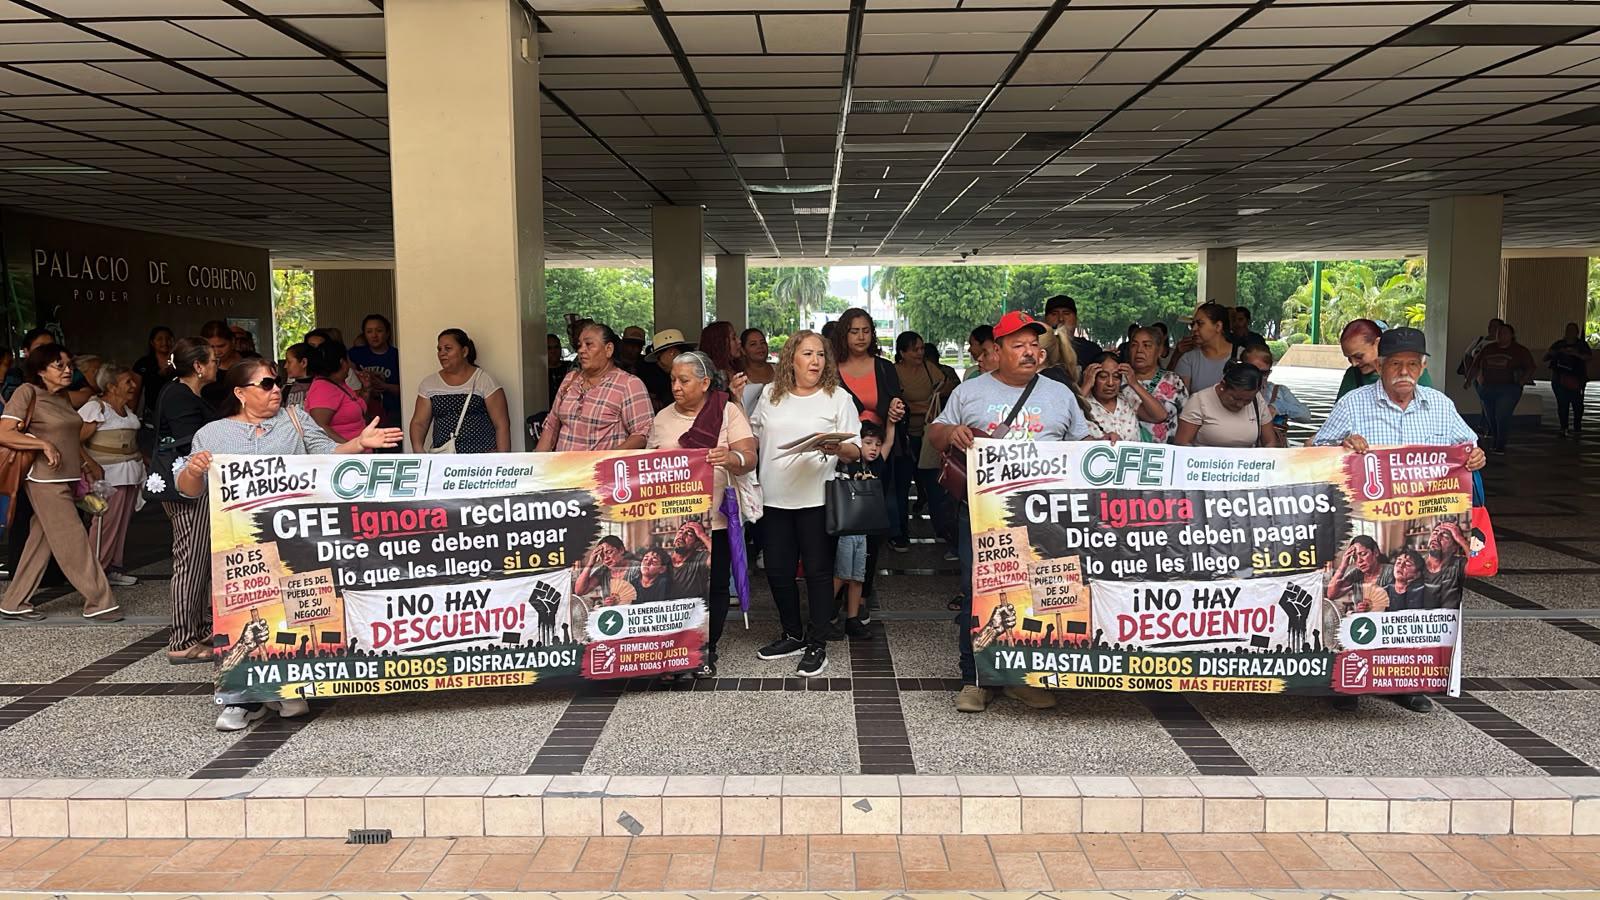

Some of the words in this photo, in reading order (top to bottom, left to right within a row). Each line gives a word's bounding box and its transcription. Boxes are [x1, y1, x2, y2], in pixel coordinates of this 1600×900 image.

[35, 249, 129, 282] PALACIO
[149, 260, 170, 285] DE
[189, 266, 256, 291] GOBIERNO
[74, 289, 128, 302] PODER
[156, 293, 235, 306] EJECUTIVO
[978, 442, 1038, 467] ¡BASTA
[1389, 454, 1403, 466] EL
[1406, 452, 1447, 465] CALOR
[221, 457, 286, 483] ¡BASTA
[638, 460, 651, 471] EL
[654, 456, 689, 470] CALOR
[976, 469, 994, 485] DE
[1001, 455, 1067, 481] ABUSOS!
[1081, 445, 1165, 486] CFE
[1187, 458, 1233, 469] Comisión
[1237, 459, 1275, 470] Federal
[331, 459, 421, 499] CFE
[444, 466, 492, 477] Comisión
[496, 466, 533, 476] Federal
[639, 469, 690, 484] EXTREMO
[1187, 471, 1198, 481] de
[1202, 472, 1260, 482] Electricidad
[1391, 465, 1449, 480] EXTREMO
[221, 486, 239, 502] DE
[246, 469, 317, 498] ABUSOS!
[443, 480, 454, 489] de
[458, 479, 517, 489] Electricidad
[640, 487, 653, 498] NO
[656, 485, 668, 496] DA
[670, 481, 703, 494] TREGUA
[1392, 483, 1407, 494] NO
[1410, 482, 1424, 493] DA
[1427, 478, 1460, 490] TREGUA
[620, 502, 657, 517] +40°C
[662, 498, 702, 507] TEMPERATURAS
[662, 506, 692, 514] EXTREMAS
[1025, 494, 1090, 523] CFE
[1100, 492, 1194, 528] ignora
[1205, 492, 1336, 518] reclamos.
[1372, 501, 1413, 516] +40°C
[1418, 505, 1448, 514] EXTREMAS
[273, 507, 341, 539] CFE
[351, 505, 448, 540] ignora
[460, 498, 587, 526] reclamos.
[978, 536, 994, 548] NO
[998, 534, 1012, 545] ES
[1066, 527, 1117, 548] Dice
[1127, 529, 1167, 548] que
[1179, 526, 1245, 545] deben
[1254, 524, 1317, 546] pagar
[317, 540, 369, 562] Dice
[379, 539, 421, 560] que
[431, 532, 498, 553] deben
[507, 527, 567, 550] pagar
[226, 553, 244, 566] NO
[247, 550, 263, 561] ES
[978, 546, 1019, 562] ERROR,
[1086, 557, 1104, 574] lo
[1112, 557, 1148, 576] que
[1156, 553, 1184, 572] les
[1193, 552, 1239, 575] llego
[1252, 547, 1271, 568] si
[1279, 553, 1292, 567] o
[1299, 545, 1317, 565] si
[226, 562, 270, 580] ERROR,
[338, 568, 356, 586] lo
[363, 568, 400, 587] que
[408, 562, 437, 579] les
[445, 557, 492, 578] llego
[504, 551, 521, 569] si
[528, 554, 541, 567] o
[548, 547, 565, 566] si
[977, 564, 991, 575] ES
[994, 560, 1019, 572] ROBO
[1036, 565, 1049, 575] CFE
[1051, 564, 1061, 573] ES
[1063, 562, 1076, 572] DEL
[225, 582, 240, 593] ES
[244, 575, 270, 590] ROBO
[287, 579, 301, 589] CFE
[304, 578, 313, 587] ES
[315, 575, 328, 586] DEL
[976, 572, 1027, 589] LEGALIZADO
[225, 588, 279, 607] LEGALIZADO
[287, 588, 317, 599] PUEBLO,
[1047, 587, 1058, 596] DE
[1059, 585, 1069, 594] SU
[299, 600, 309, 608] DE
[312, 597, 322, 606] SU
[387, 593, 434, 619] ¡NO
[445, 589, 491, 612] HAY
[1041, 595, 1077, 606] NEGOCIO!
[1134, 589, 1181, 612] ¡NO
[1193, 587, 1241, 609] HAY
[294, 607, 330, 619] NEGOCIO!
[628, 608, 636, 616] LA
[638, 605, 663, 615] ENERGÍA
[665, 602, 695, 613] ELÉCTRICA
[628, 615, 640, 625] NO
[643, 614, 653, 624] ES
[655, 613, 667, 623] UN
[670, 611, 691, 623] LUJO,
[1117, 605, 1275, 642] DESCUENTO!
[1382, 616, 1390, 624] LA
[1391, 613, 1420, 623] ENERGÍA
[1421, 613, 1456, 622] ELÉCTRICA
[371, 604, 525, 649] DESCUENTO!
[628, 626, 636, 634] ES
[637, 624, 649, 633] UNA
[651, 622, 683, 632] NECESIDAD
[1382, 625, 1394, 635] NO
[1397, 625, 1408, 635] ES
[1411, 624, 1423, 635] UN
[1426, 624, 1452, 635] LUJO,
[620, 642, 658, 652] FIRMEMOS
[661, 640, 674, 649] POR
[1382, 636, 1390, 644] ES
[1407, 635, 1441, 643] NECESIDAD
[620, 653, 631, 662] UN
[634, 651, 663, 661] PRECIO
[664, 647, 688, 659] JUSTO
[1373, 655, 1414, 665] FIRMEMOS
[1417, 655, 1433, 665] POR
[247, 665, 278, 686] ¡YA
[288, 662, 350, 682] BASTA
[356, 661, 378, 678] DE
[384, 657, 447, 677] ROBOS
[454, 650, 576, 673] DISFRAZADOS!
[620, 663, 638, 671] PARA
[640, 661, 661, 670] TODAS
[668, 658, 689, 667] TODOS
[995, 651, 1026, 670] ¡YA
[1032, 652, 1092, 673] BASTA
[1099, 655, 1122, 673] DE
[1129, 657, 1192, 675] ROBOS
[1199, 657, 1327, 676] DISFRAZADOS!
[1373, 666, 1385, 676] UN
[1387, 666, 1419, 676] PRECIO
[333, 681, 380, 694] UNIDOS
[385, 679, 429, 691] SOMOS
[435, 675, 463, 688] MÁS
[468, 673, 525, 686] FUERTES!
[1076, 676, 1123, 688] UNIDOS
[1128, 678, 1172, 689] SOMOS
[1179, 677, 1208, 690] MÁS
[1213, 680, 1272, 691] FUERTES!
[1373, 679, 1391, 687] PARA
[1393, 679, 1418, 687] TODAS
[1420, 679, 1425, 687] Y
[1427, 679, 1447, 687] TODO
